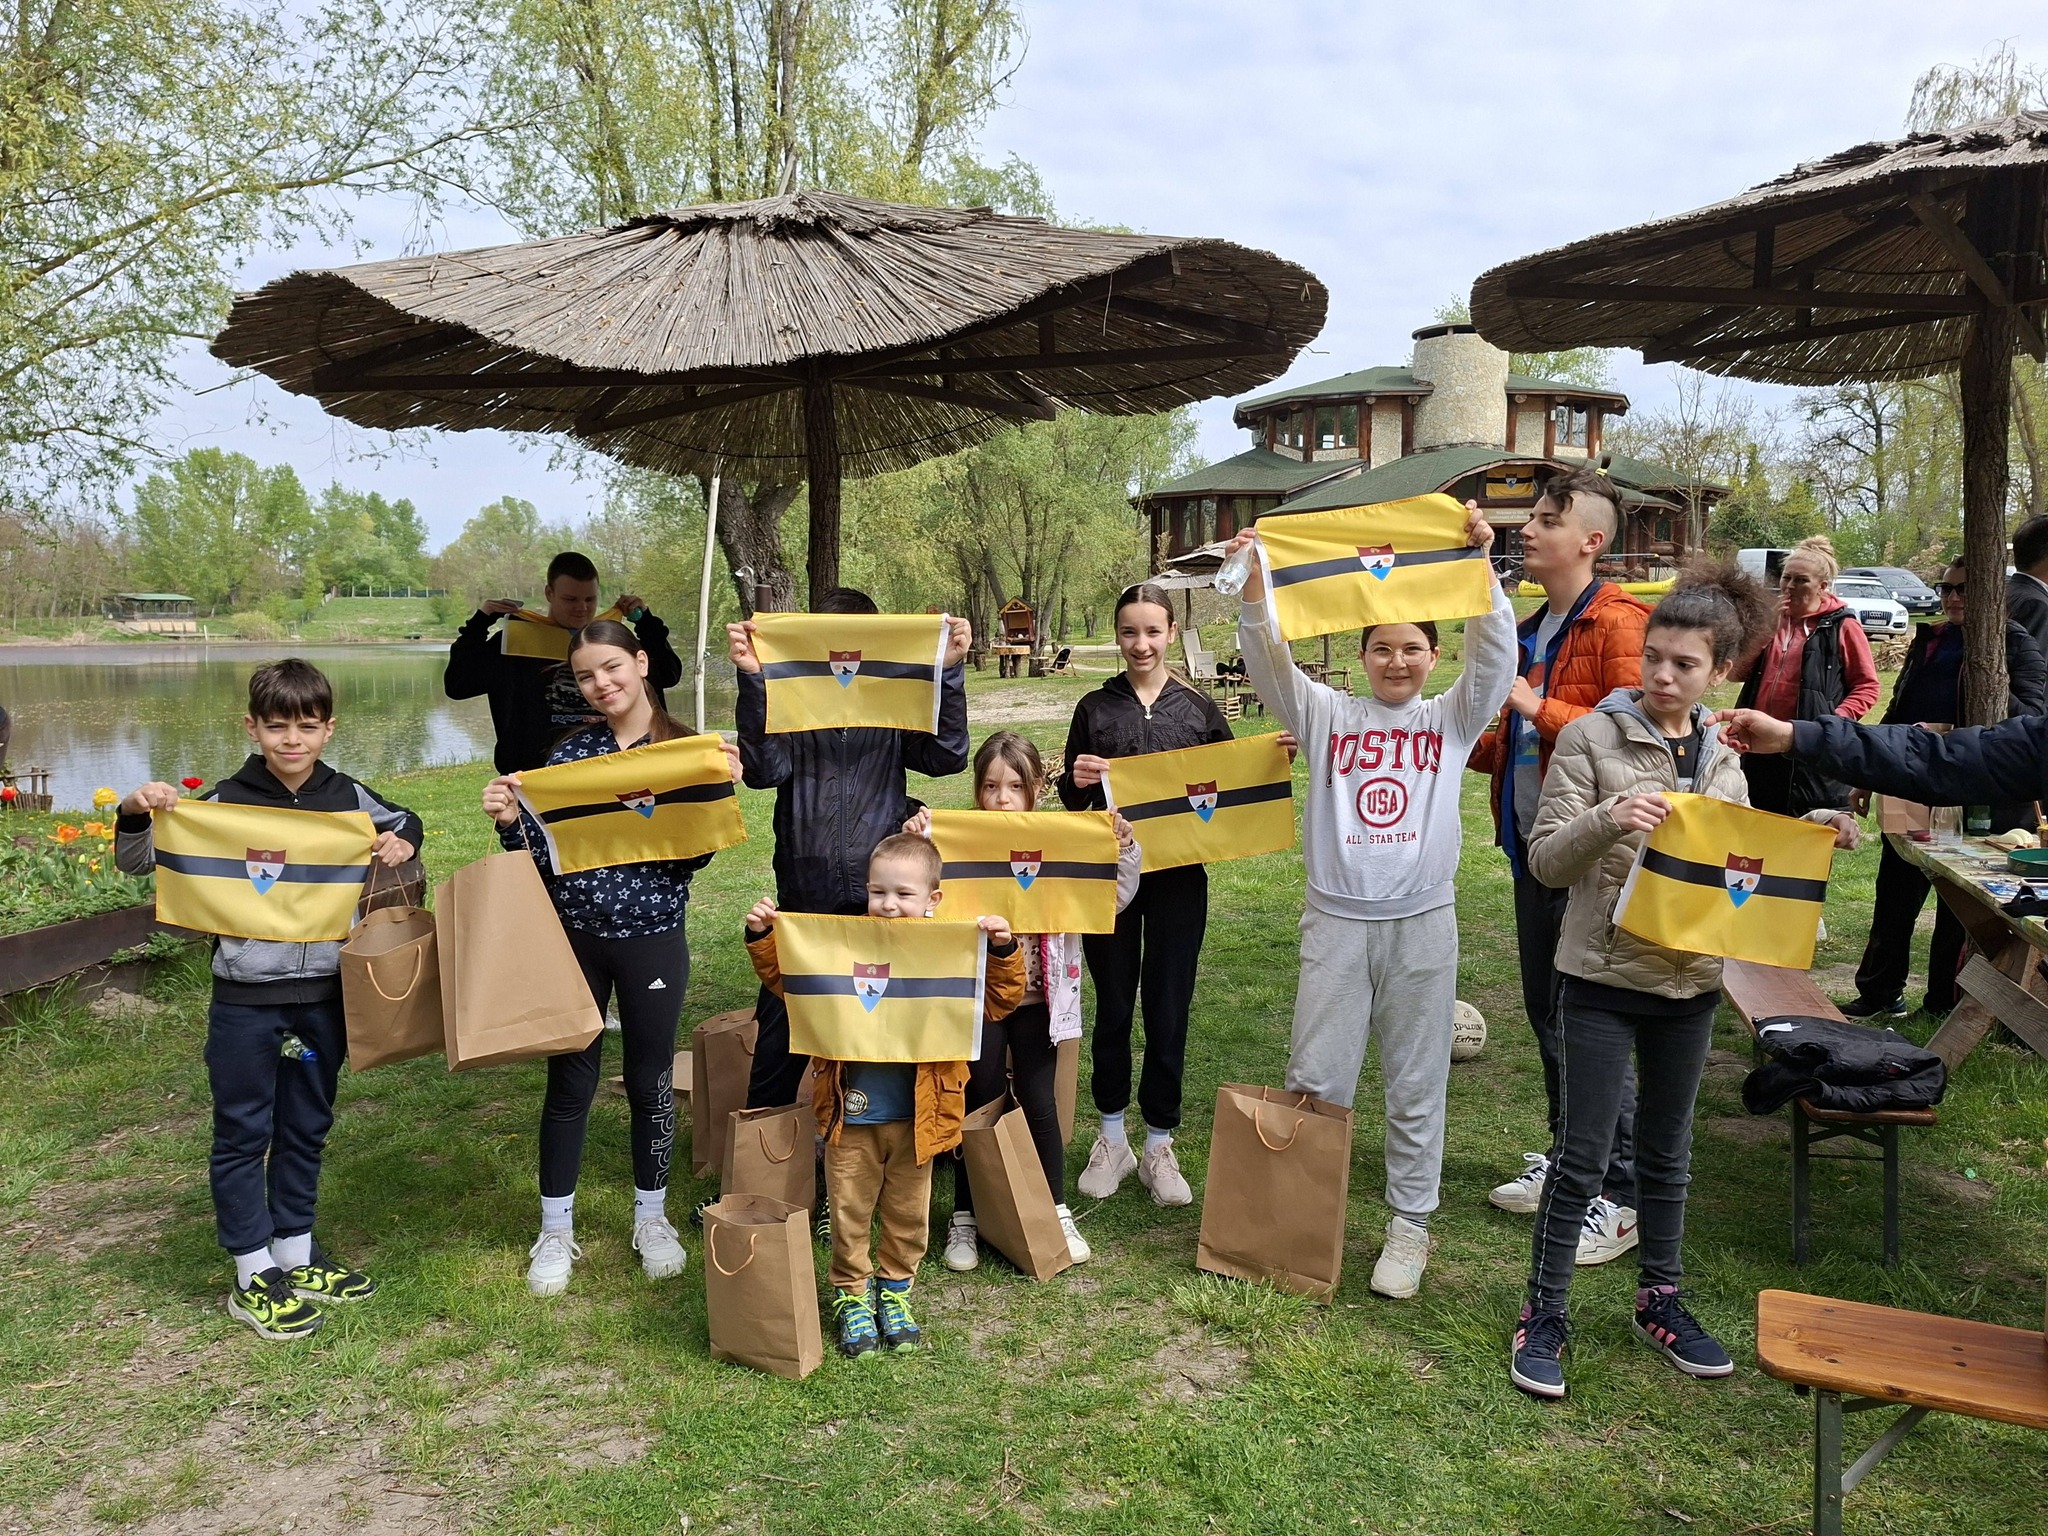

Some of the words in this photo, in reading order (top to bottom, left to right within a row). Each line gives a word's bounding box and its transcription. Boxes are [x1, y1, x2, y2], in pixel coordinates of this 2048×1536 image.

[1366, 787, 1398, 816] USA
[1345, 834, 1362, 845] ALL
[1369, 833, 1393, 845] STAR
